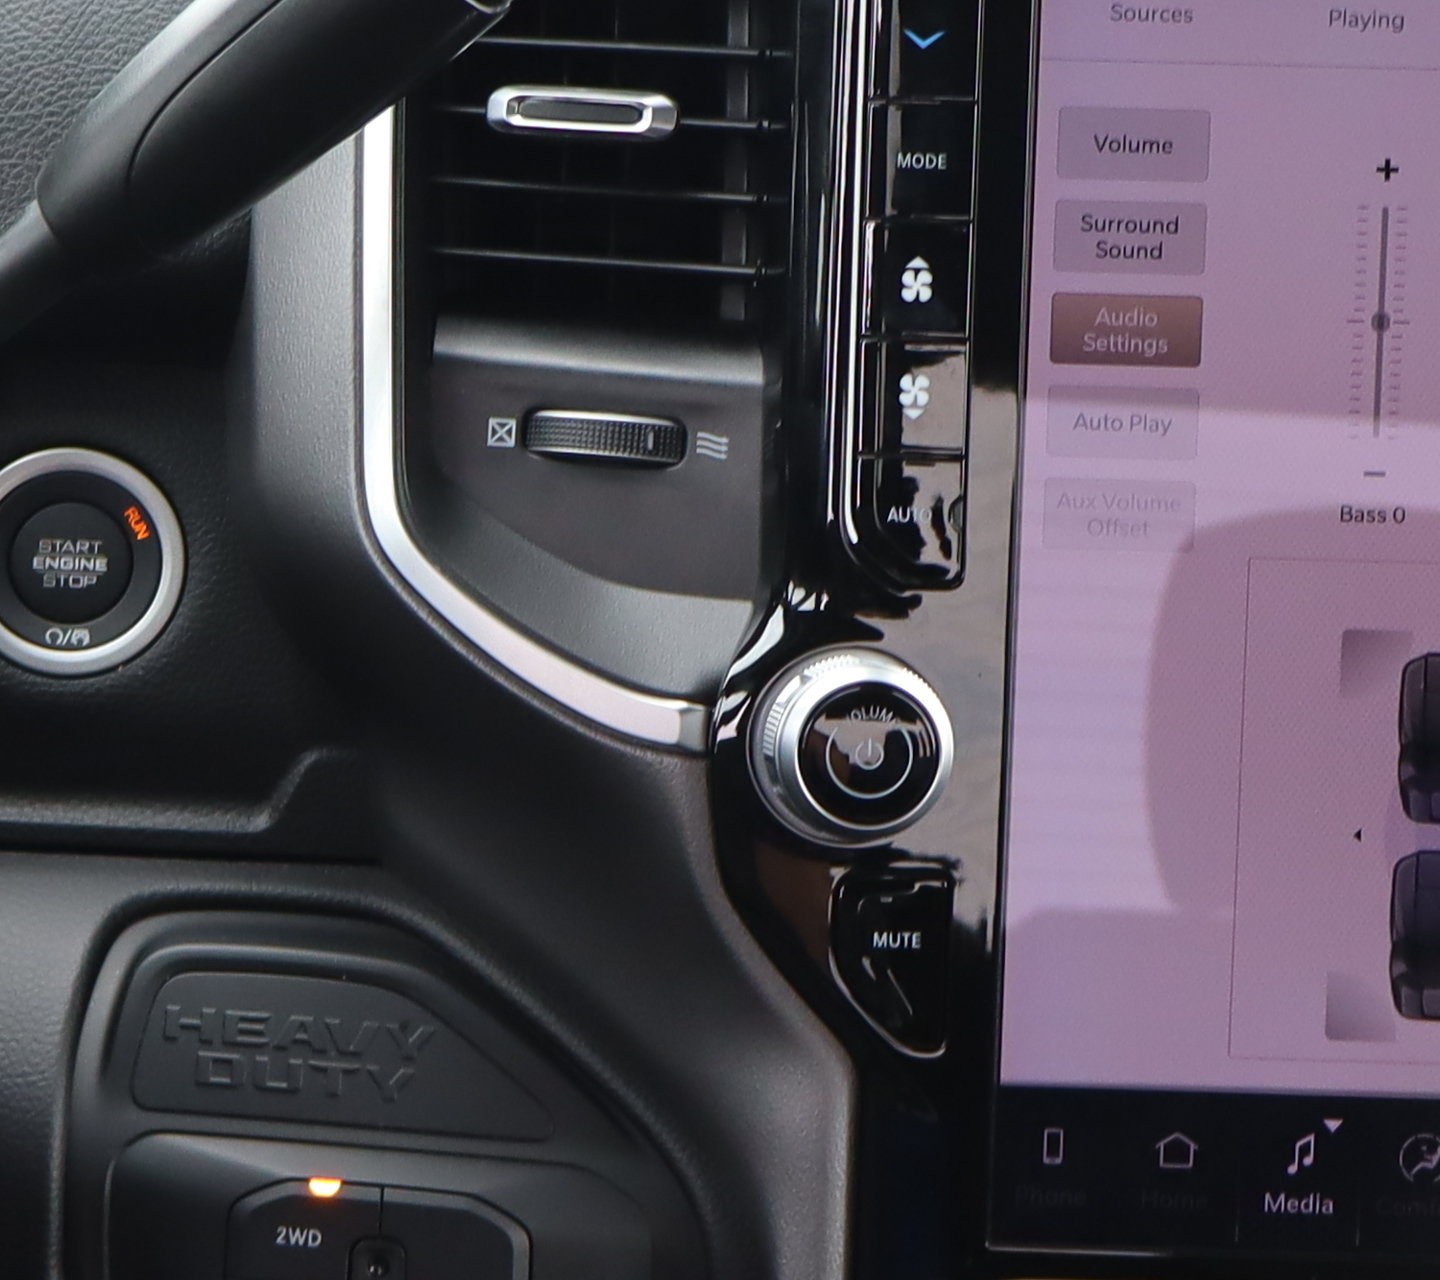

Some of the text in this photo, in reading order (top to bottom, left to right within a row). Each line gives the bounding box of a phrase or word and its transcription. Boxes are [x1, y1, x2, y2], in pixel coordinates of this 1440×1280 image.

[1110, 3, 1194, 24] Sources
[1328, 8, 1405, 34] Playing
[1093, 134, 1173, 154] Volume
[896, 152, 948, 170] MODE
[1081, 214, 1180, 235] Surround
[1095, 240, 1164, 261] Sound
[1094, 306, 1159, 328] Audio
[1082, 332, 1168, 357] Settings
[1072, 412, 1173, 437] Auto Play
[1056, 492, 1181, 513] Aux Volume
[123, 506, 151, 541] RUN
[887, 506, 932, 524] AUTO
[1339, 505, 1406, 525] Bass 0
[1087, 519, 1149, 537] Offset
[38, 539, 102, 554] START
[33, 556, 108, 571] ENGINE
[43, 574, 97, 589] STOP
[873, 931, 921, 949] MUTE
[163, 1004, 435, 1061] HEAVY
[194, 1051, 416, 1103] DUTY
[1264, 1191, 1335, 1215] Media
[276, 1225, 322, 1247] 2WD
